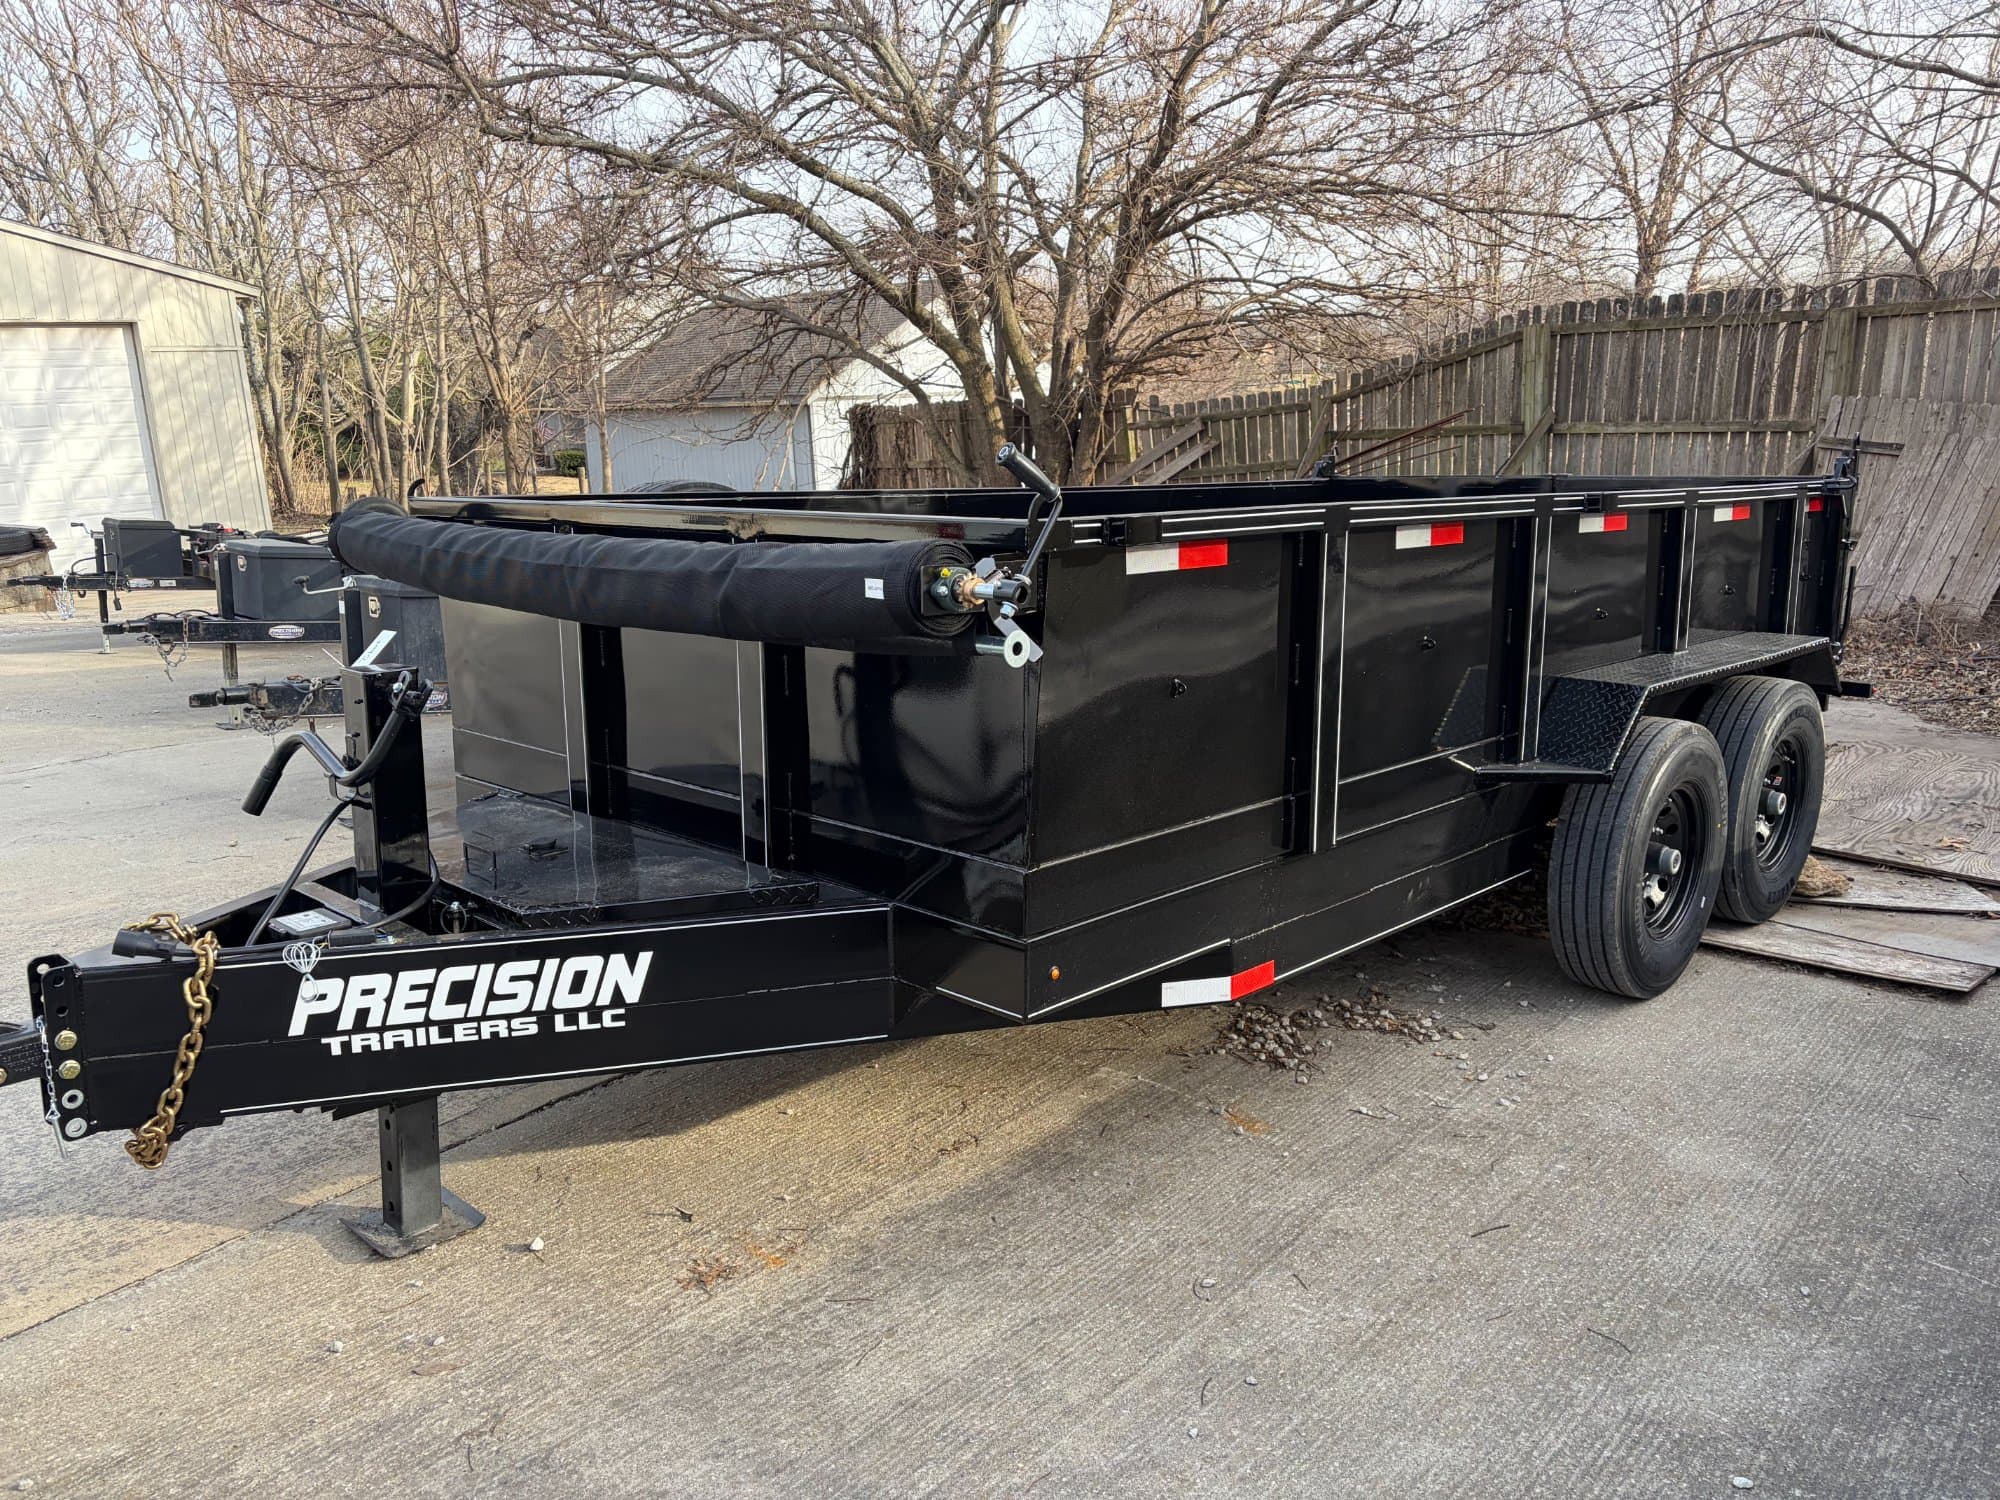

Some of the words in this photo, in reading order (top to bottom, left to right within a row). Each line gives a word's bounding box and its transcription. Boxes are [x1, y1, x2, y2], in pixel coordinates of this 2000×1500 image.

[287, 951, 654, 1037] PRECISION
[320, 1016, 539, 1056] TRAILERS
[554, 1008, 626, 1033] LLC
